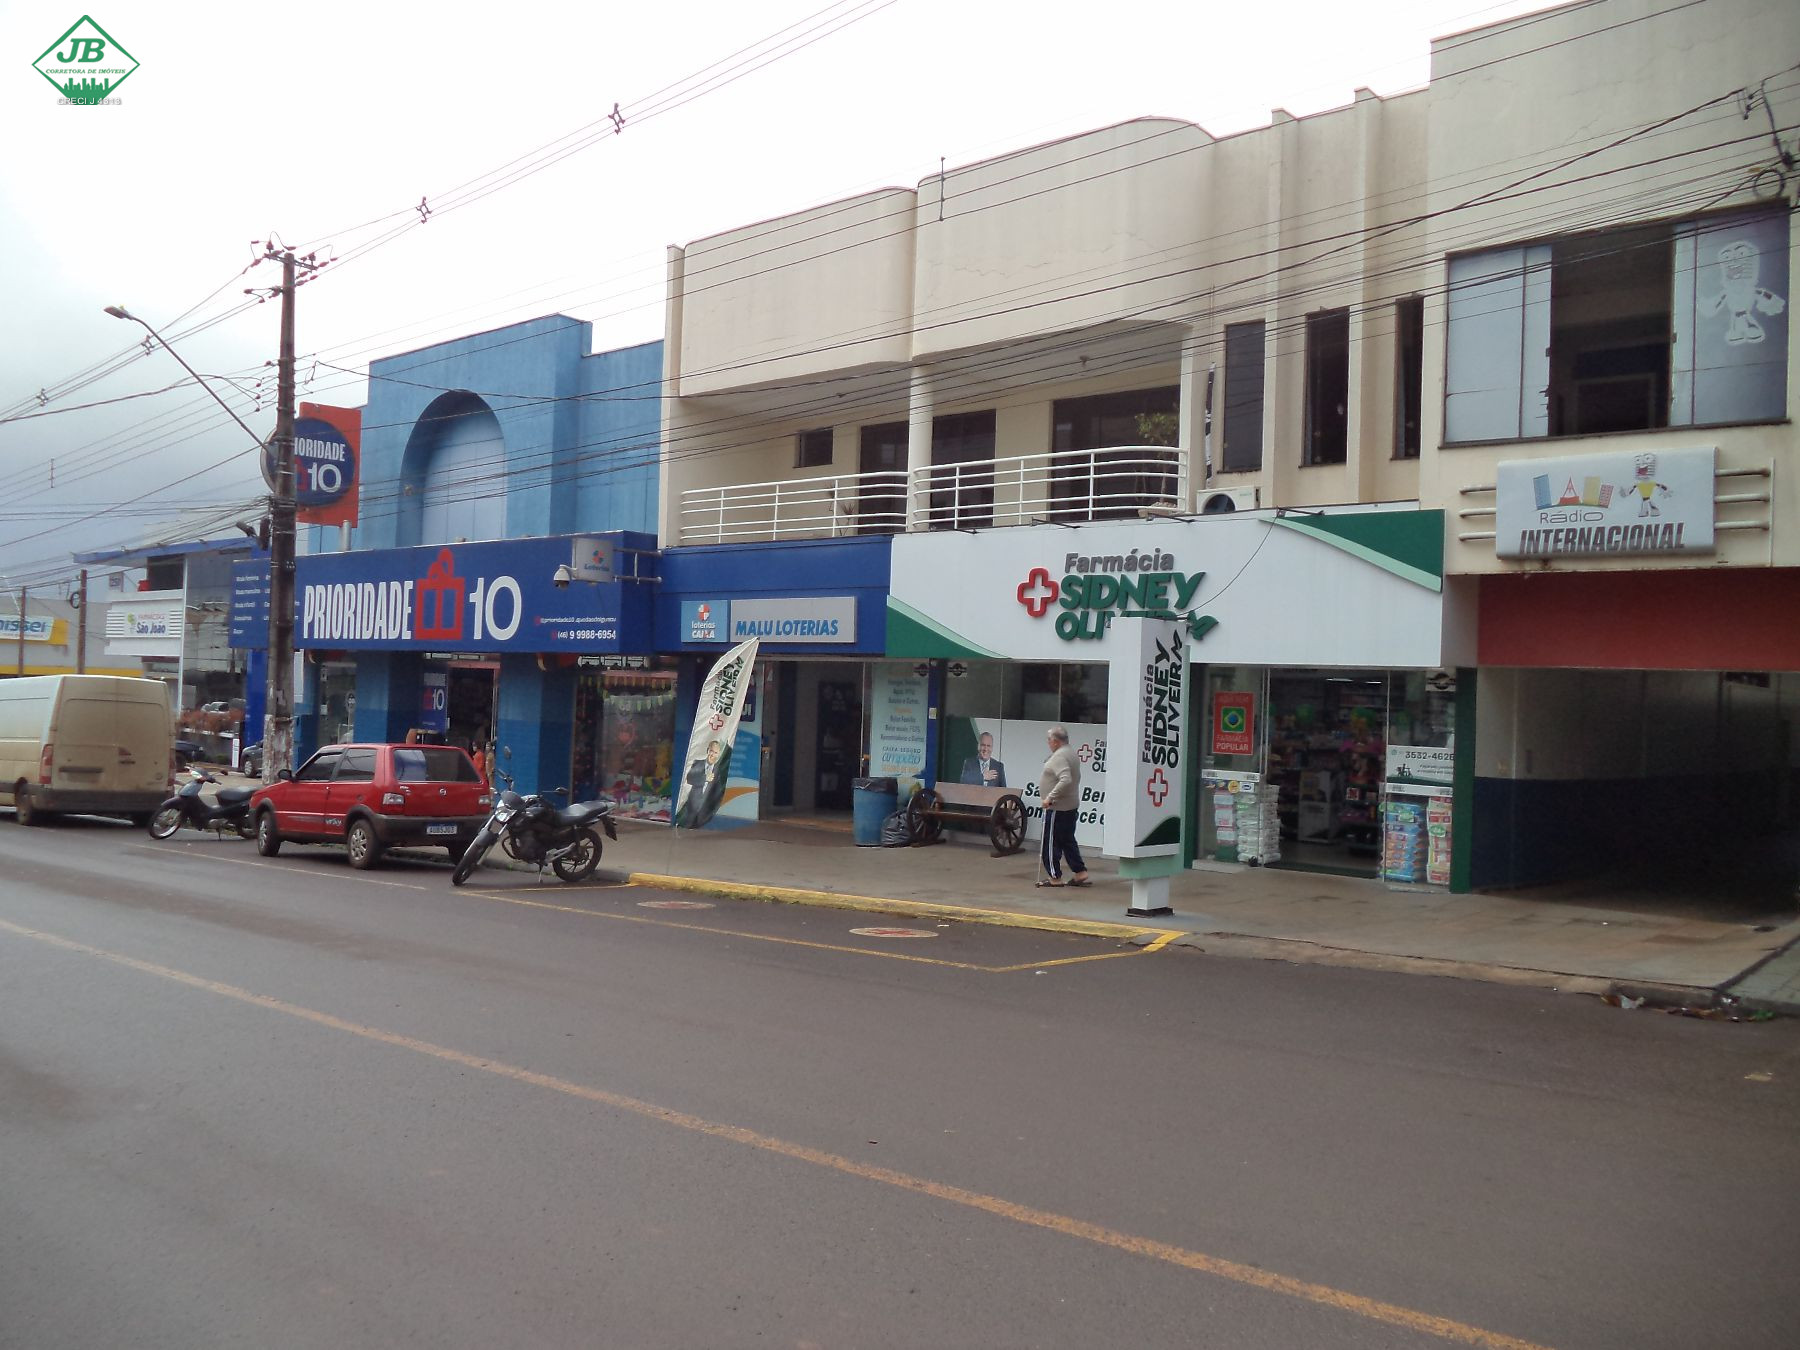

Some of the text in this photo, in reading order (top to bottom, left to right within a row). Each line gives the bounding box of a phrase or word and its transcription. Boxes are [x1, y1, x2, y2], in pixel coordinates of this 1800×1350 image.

[294, 437, 346, 462] IORIDADE
[307, 462, 342, 493] 10
[1539, 510, 1605, 525] Rádio
[1519, 522, 1686, 555] INTERNACIONAL
[1064, 547, 1174, 573] Farmácia
[1058, 571, 1206, 610] SIDNEY
[302, 575, 523, 641] PRIORIDADE 10
[569, 630, 575, 639] 9
[576, 629, 617, 640] 9988-6954
[691, 621, 716, 630] loterias
[691, 629, 716, 639] CAIXA
[735, 619, 839, 636] MALU LOTERIAS
[432, 688, 445, 711] 10
[1151, 636, 1173, 766] SIDNEY
[1167, 628, 1183, 769] OLIVEIRA
[1142, 663, 1155, 764] Farmácia
[1215, 742, 1249, 751] POPULAR
